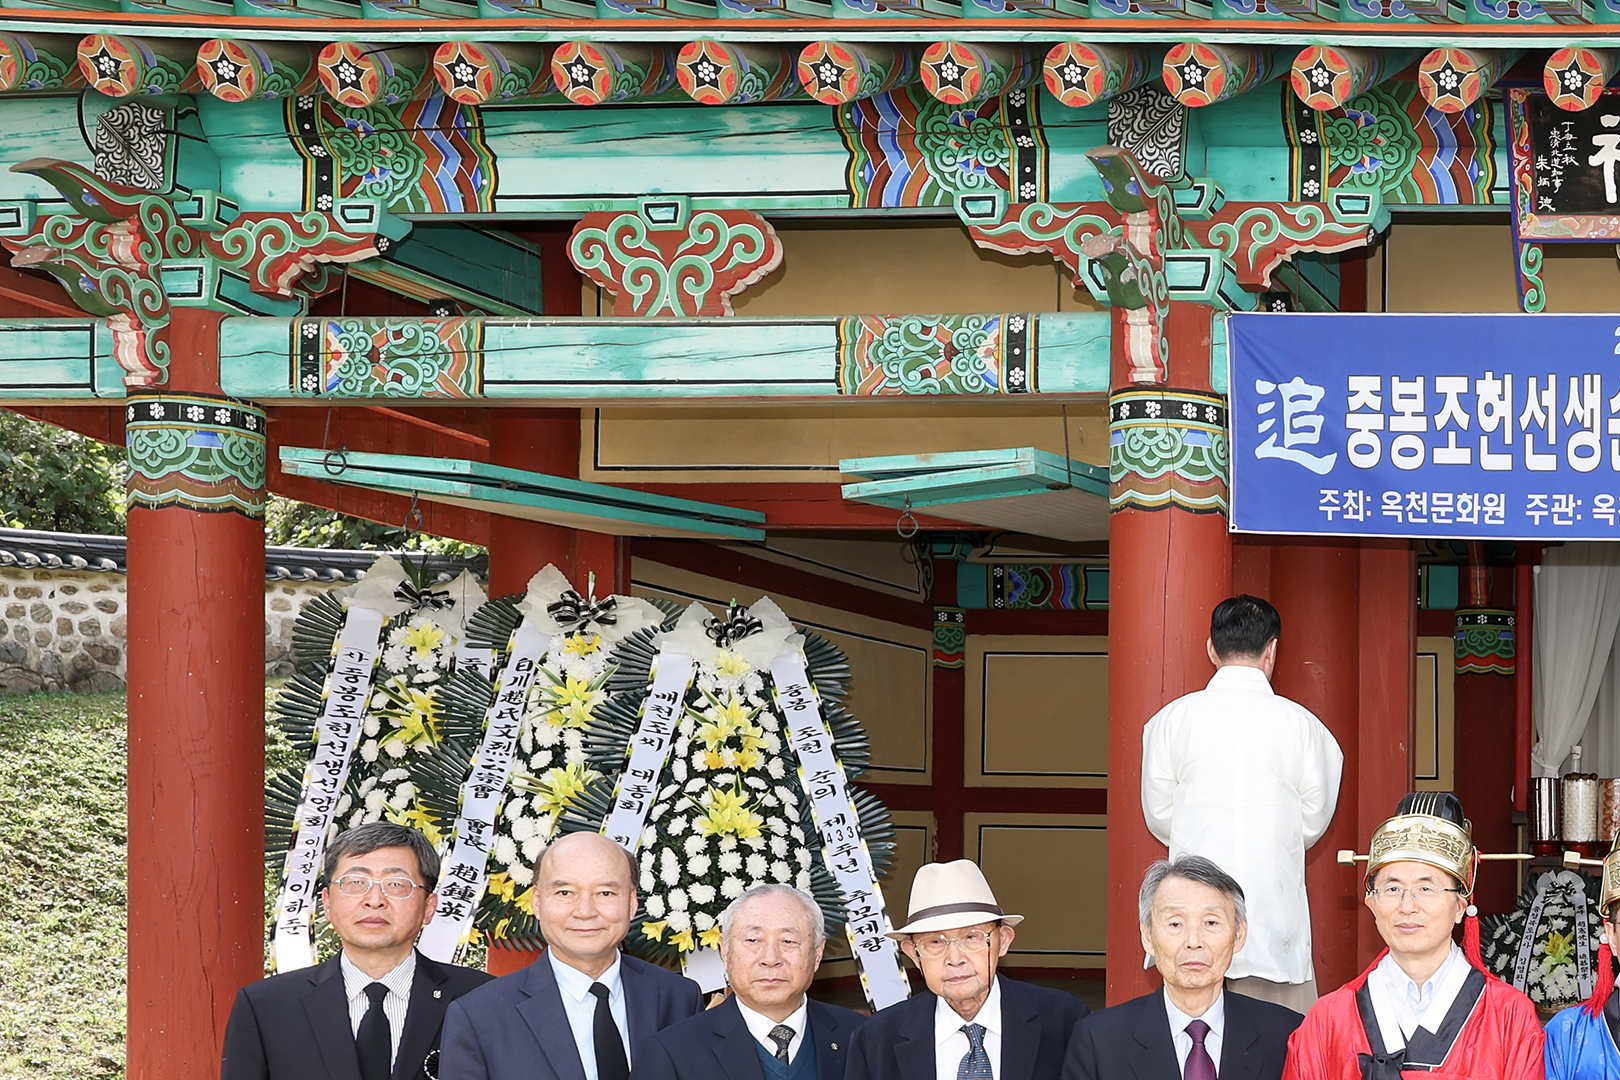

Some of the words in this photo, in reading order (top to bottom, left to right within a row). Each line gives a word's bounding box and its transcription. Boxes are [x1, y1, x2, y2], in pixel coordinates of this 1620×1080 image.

[1254, 376, 1338, 475] 追
[1318, 489, 1372, 522] 주최:
[1380, 490, 1506, 526] 옥천문화원
[1525, 493, 1583, 526] 주관:
[780, 683, 812, 711] 중봉
[639, 690, 679, 752] 배천조씨
[796, 726, 823, 754] 조헌
[618, 768, 655, 816] 대동회
[808, 770, 837, 800] 순의
[845, 889, 886, 952] 추모제향
